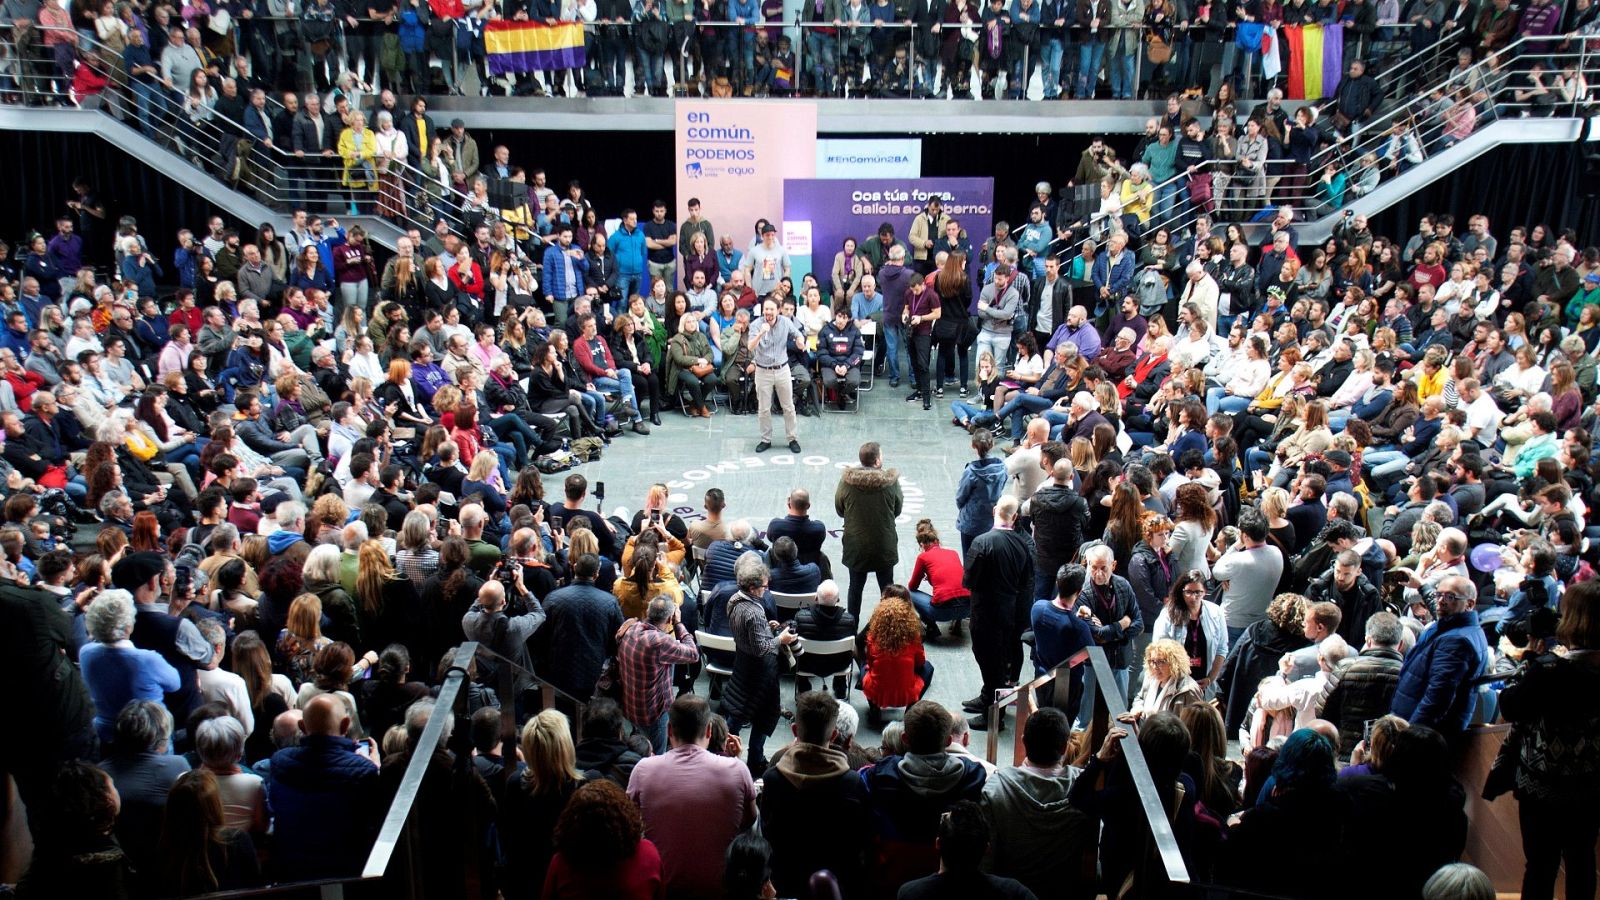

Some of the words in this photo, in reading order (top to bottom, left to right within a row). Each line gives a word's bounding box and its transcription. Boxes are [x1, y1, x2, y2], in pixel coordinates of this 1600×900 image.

[687, 112, 710, 123] en
[687, 124, 755, 139] común.
[686, 148, 755, 160] PODEMOS
[727, 167, 755, 176] equo
[883, 188, 909, 201] túa
[902, 204, 922, 215] ao
[924, 203, 990, 215] berno.
